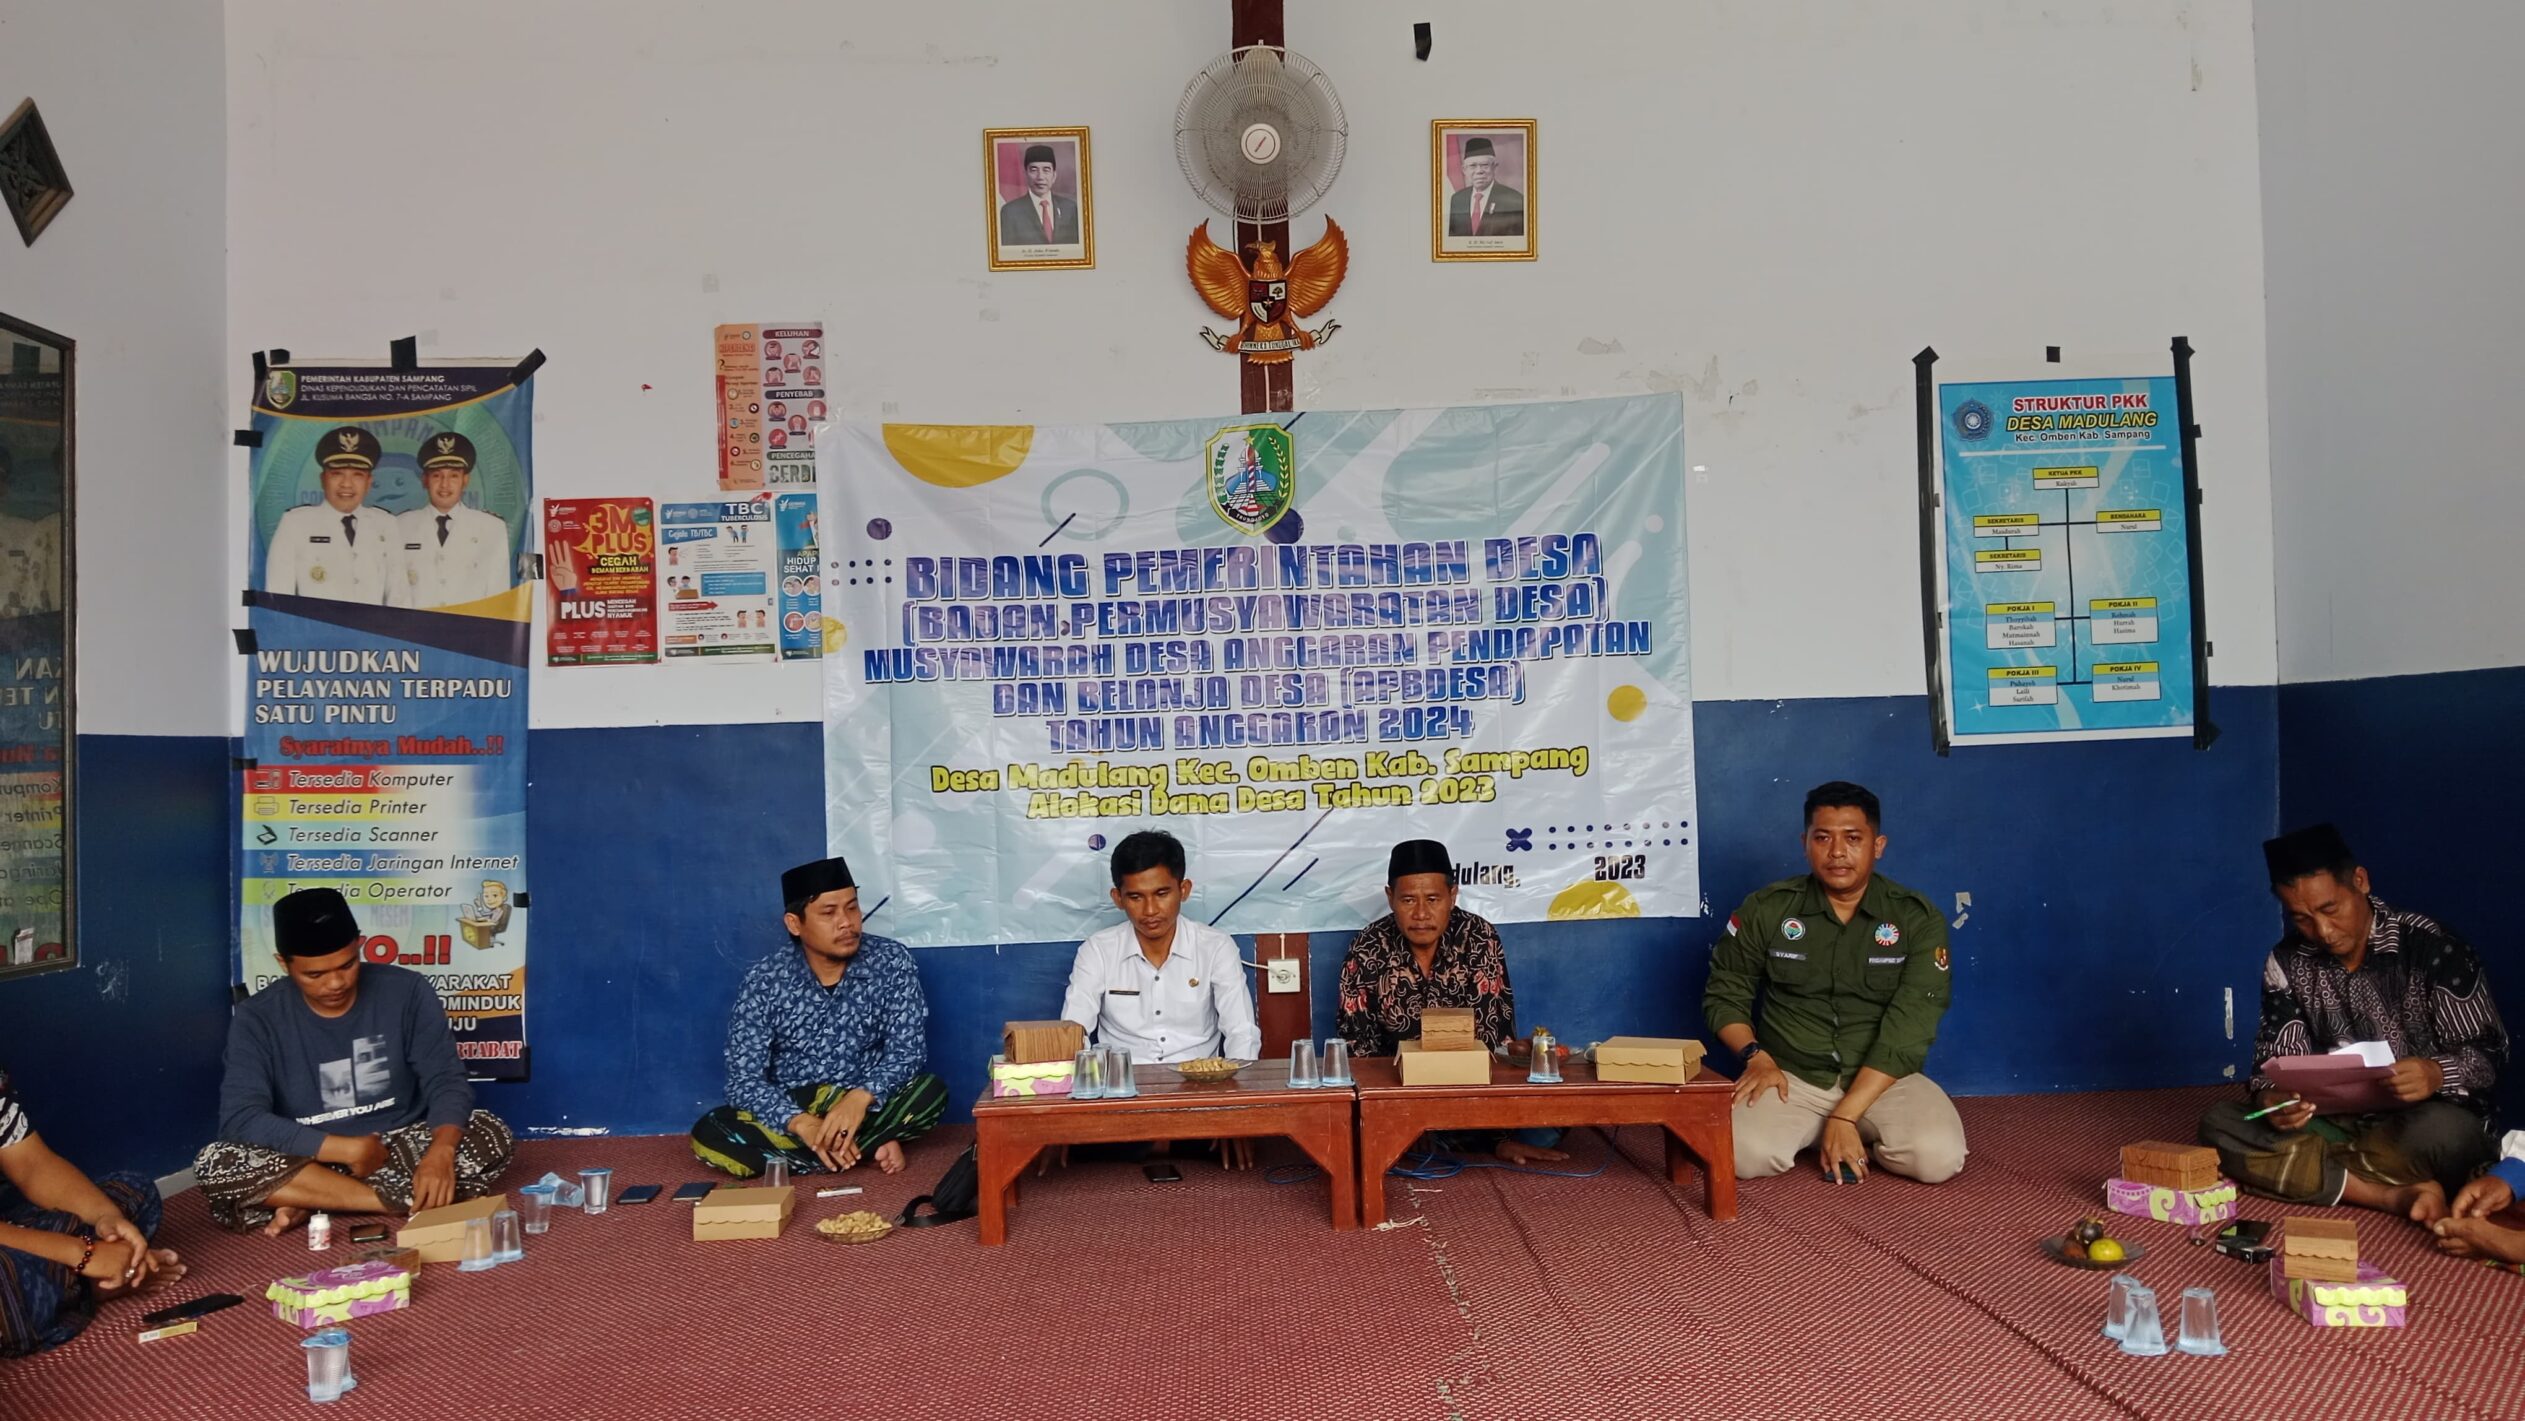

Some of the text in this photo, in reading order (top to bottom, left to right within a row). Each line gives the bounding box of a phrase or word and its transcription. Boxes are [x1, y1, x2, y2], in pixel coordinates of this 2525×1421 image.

[774, 330, 810, 338] KELUHAN
[301, 375, 445, 383] PEMERINTAH KABUPATEN SAMPANG
[301, 384, 478, 392] DINAS KEPENDUDUKAN DAN PENCATATAN SIPIL
[775, 390, 814, 398] PENYEBAB
[2013, 393, 2148, 412] STRUKTUR PKK
[2006, 411, 2159, 431] DESA MADULANG
[2040, 432, 2077, 442] Omben
[2104, 429, 2151, 441] Sampang
[771, 451, 816, 459] PENCEGAHA
[769, 464, 817, 484] CERDI
[725, 503, 763, 515] TBC
[591, 506, 635, 533] 3M
[592, 532, 648, 553] PLUS
[600, 556, 637, 567] CEGAH
[784, 565, 813, 573] SEHAT
[787, 557, 817, 565] HIDUP
[906, 532, 1605, 602] BIDANG PEMERINTAHAN DESA
[561, 601, 606, 619] PLUS
[1070, 588, 1483, 641] PERMUSYAWARATAN
[864, 619, 1653, 684] MUSYAWARAH DESA ANGGARAN PENDAPATAN
[257, 649, 421, 675] WUJUDKAN
[256, 679, 513, 699] PELAYANAN TERPADU
[994, 682, 1067, 717] DAN
[1078, 675, 1232, 716] BELANJA
[1240, 671, 1330, 710] DESA
[255, 703, 397, 724] SATU PINTU
[1046, 705, 1476, 754] TAHUN ANGGARAN 2024
[280, 736, 390, 760] Syaratnya
[931, 745, 1589, 793] Desa Madulang Kec. Omben Kab. Sampang
[289, 769, 454, 791] Tersedia Komputer
[289, 799, 427, 815] Tersedia Printer
[1026, 776, 1496, 819] Alokasi Dana Desa Tahun 2023
[288, 826, 439, 843] Tersedia Scanner
[287, 854, 520, 874] Tersedia Jaringan Internet
[1452, 854, 1647, 889] dulang, 2023
[368, 883, 454, 902] Operator
[424, 974, 513, 992] YARAKAT
[349, 1103, 374, 1116] YOU
